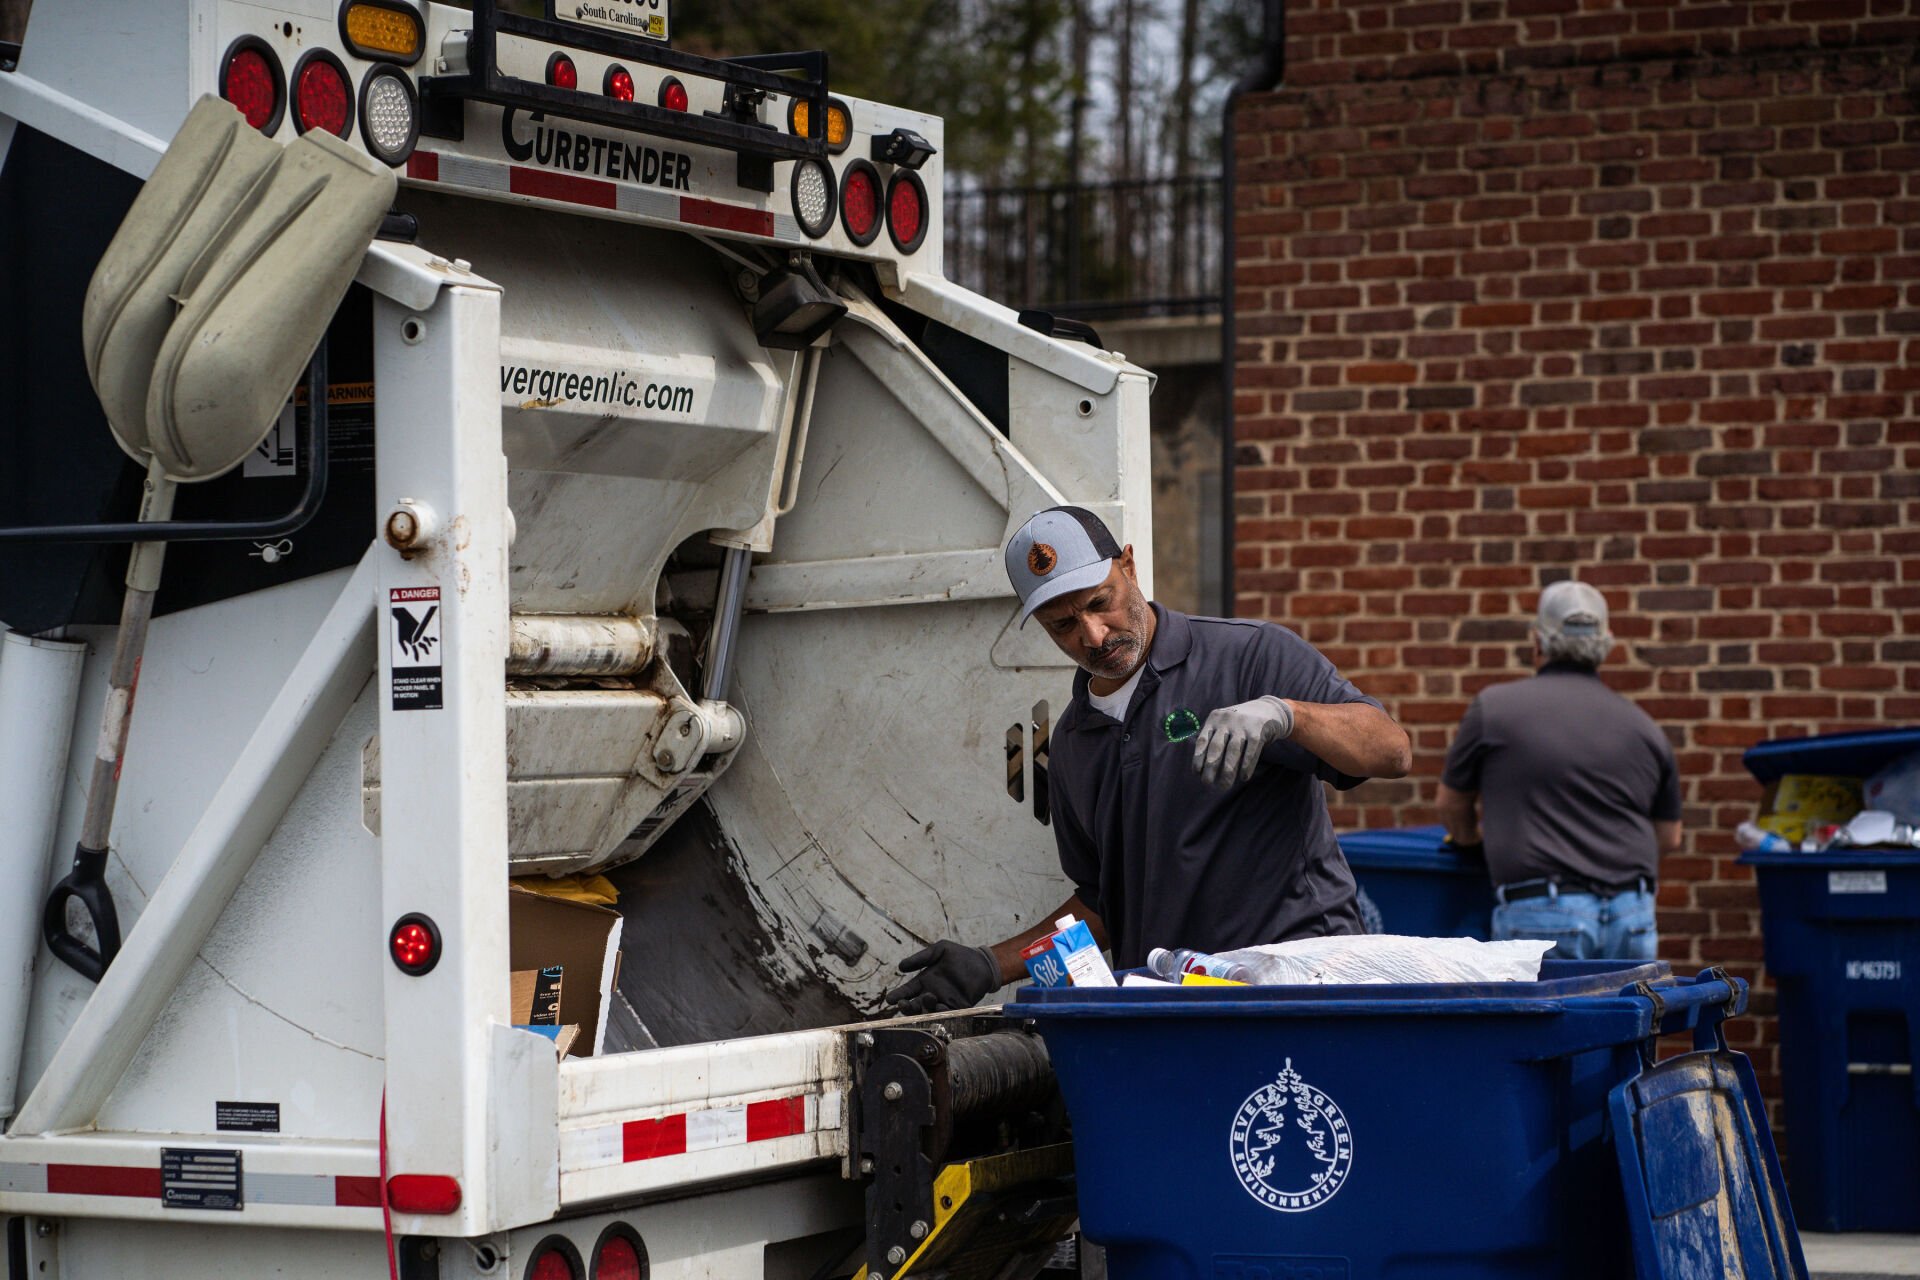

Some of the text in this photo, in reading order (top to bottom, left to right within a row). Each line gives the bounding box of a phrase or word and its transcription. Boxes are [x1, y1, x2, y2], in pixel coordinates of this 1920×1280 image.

[583, 3, 607, 19] South
[609, 8, 642, 27] Carolina
[650, 16, 663, 25] NOV
[502, 105, 691, 191] CURBTENDER
[327, 385, 375, 399] ARNING
[401, 588, 439, 599] DANGER
[1033, 954, 1065, 988] Silk
[1233, 1093, 1350, 1160] EVER GREEN
[1235, 1152, 1344, 1208] ENVIRONMENTAL
